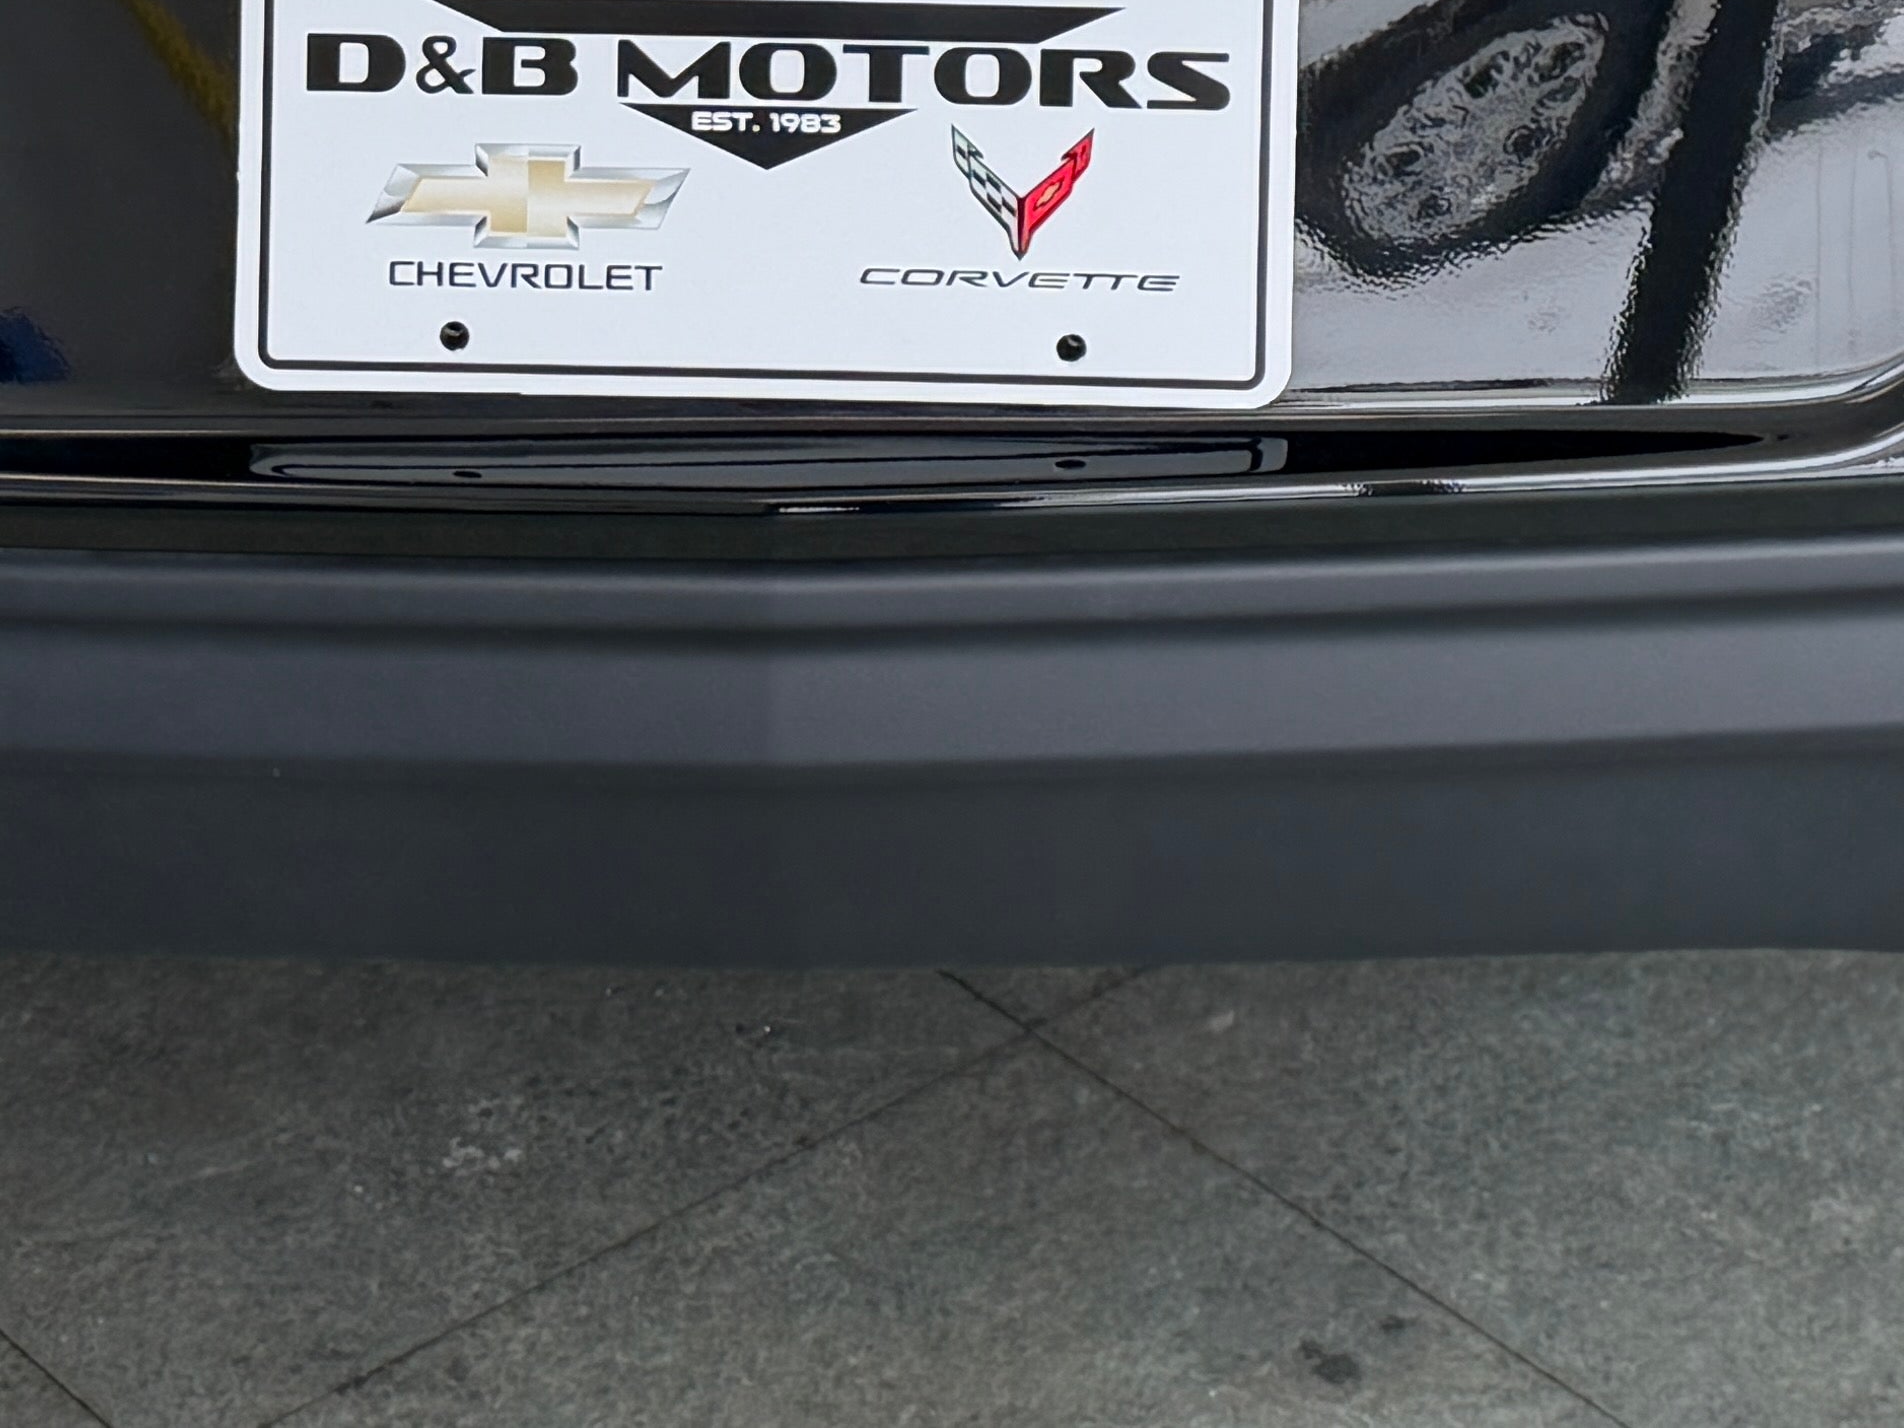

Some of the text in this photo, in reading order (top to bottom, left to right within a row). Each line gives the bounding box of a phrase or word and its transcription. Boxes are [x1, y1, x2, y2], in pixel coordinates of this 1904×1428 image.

[306, 32, 1231, 111] D&B MOTORS
[690, 110, 842, 134] EST. 1983
[389, 260, 664, 291] CHEVROLET
[859, 267, 1181, 292] CORVETTE
